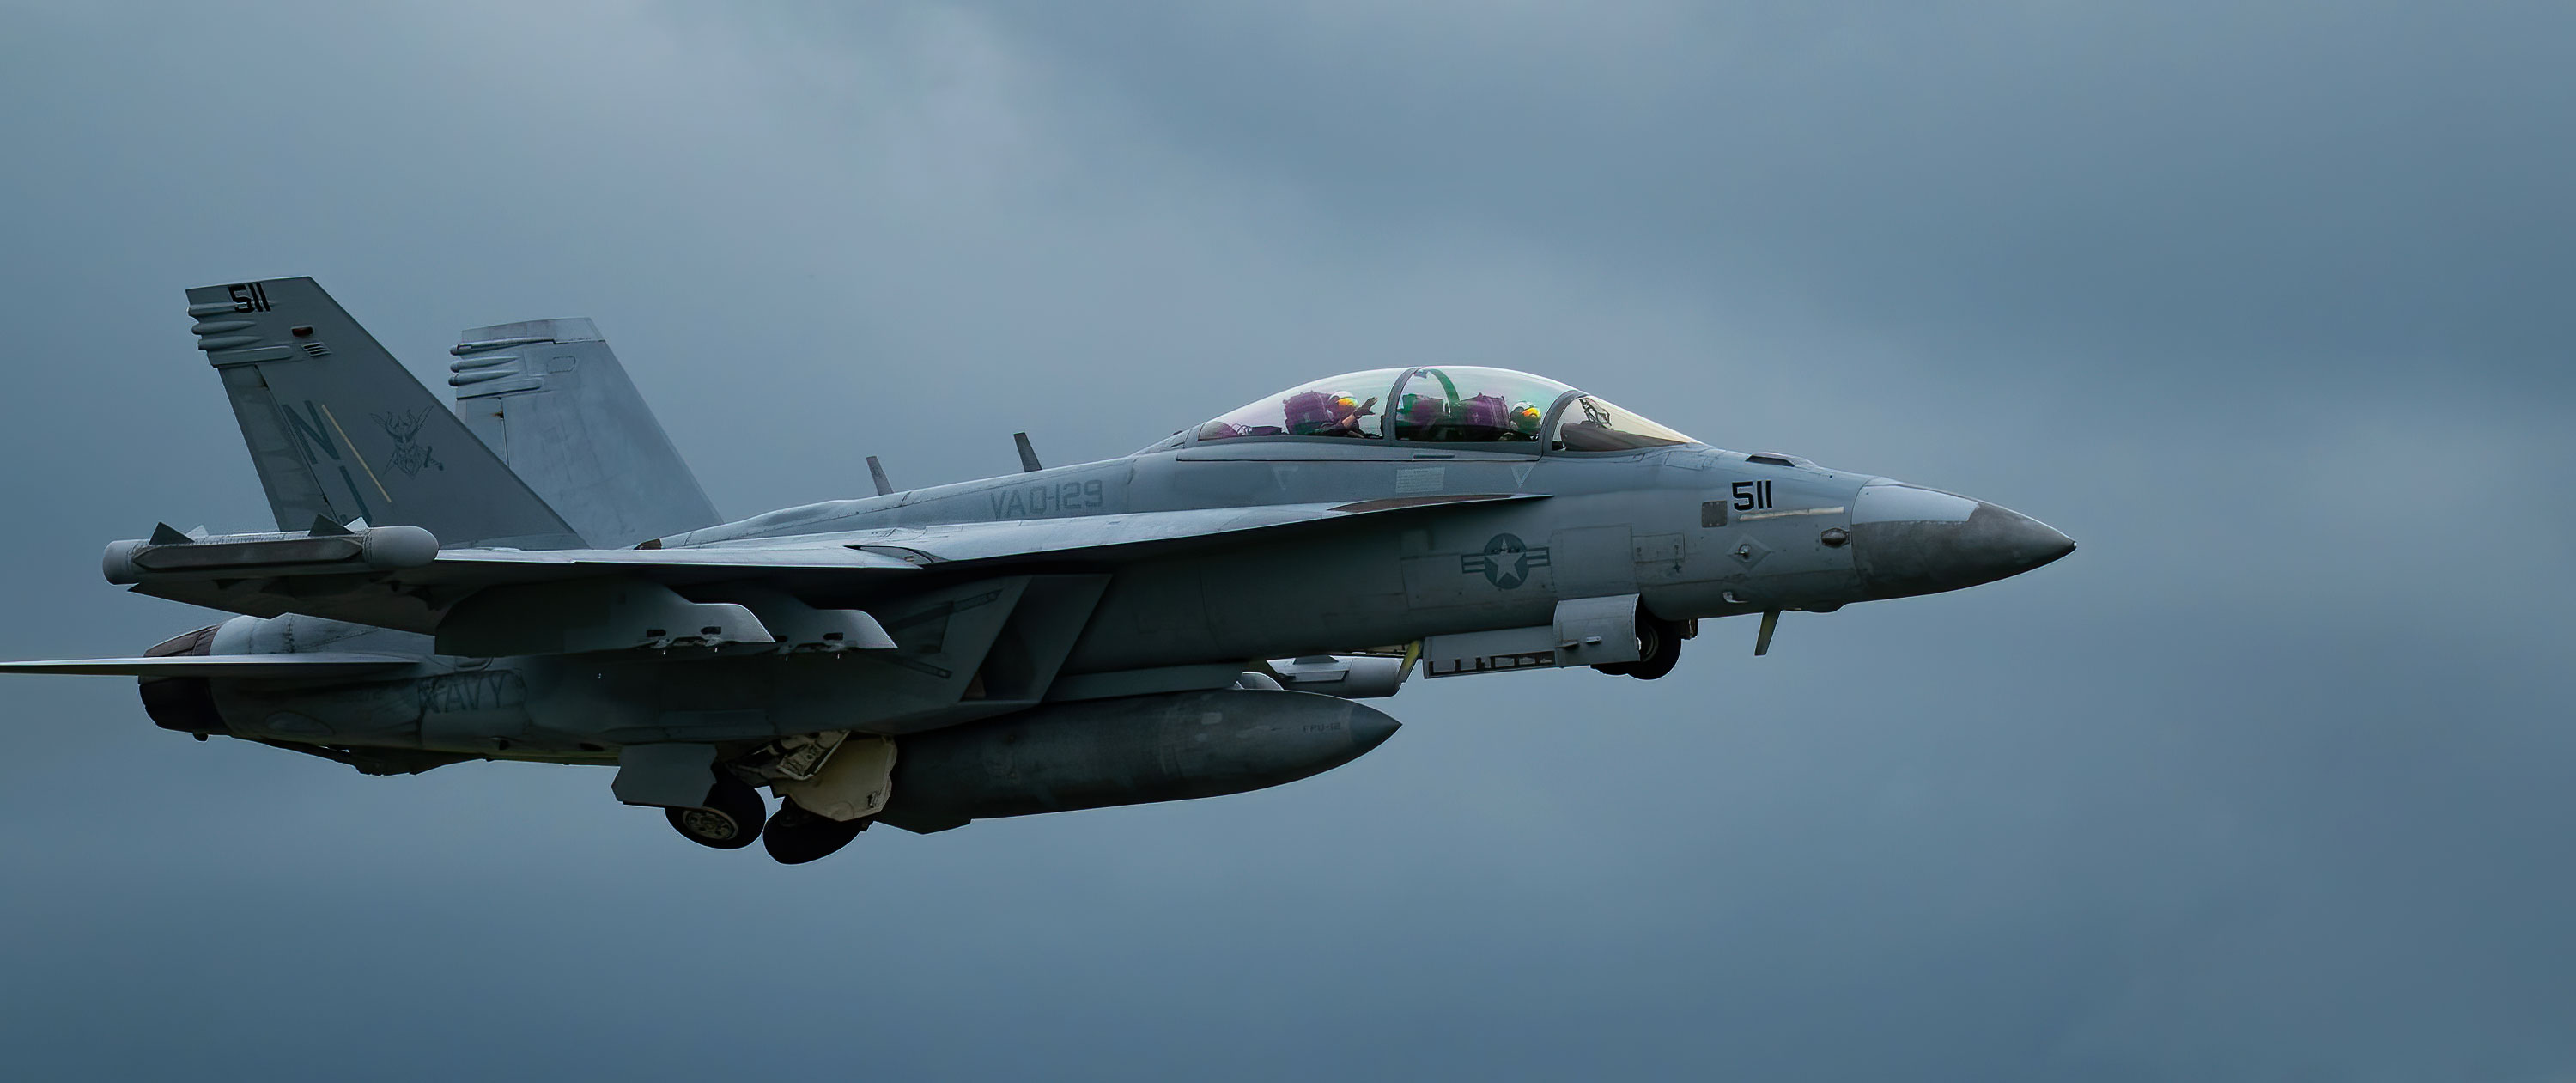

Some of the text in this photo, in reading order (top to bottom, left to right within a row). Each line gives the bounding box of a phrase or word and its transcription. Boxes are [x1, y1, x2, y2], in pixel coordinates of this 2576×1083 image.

[228, 282, 270, 313] 511
[283, 400, 340, 465] N
[1732, 480, 1772, 511] 511
[418, 672, 509, 713] NAVY
